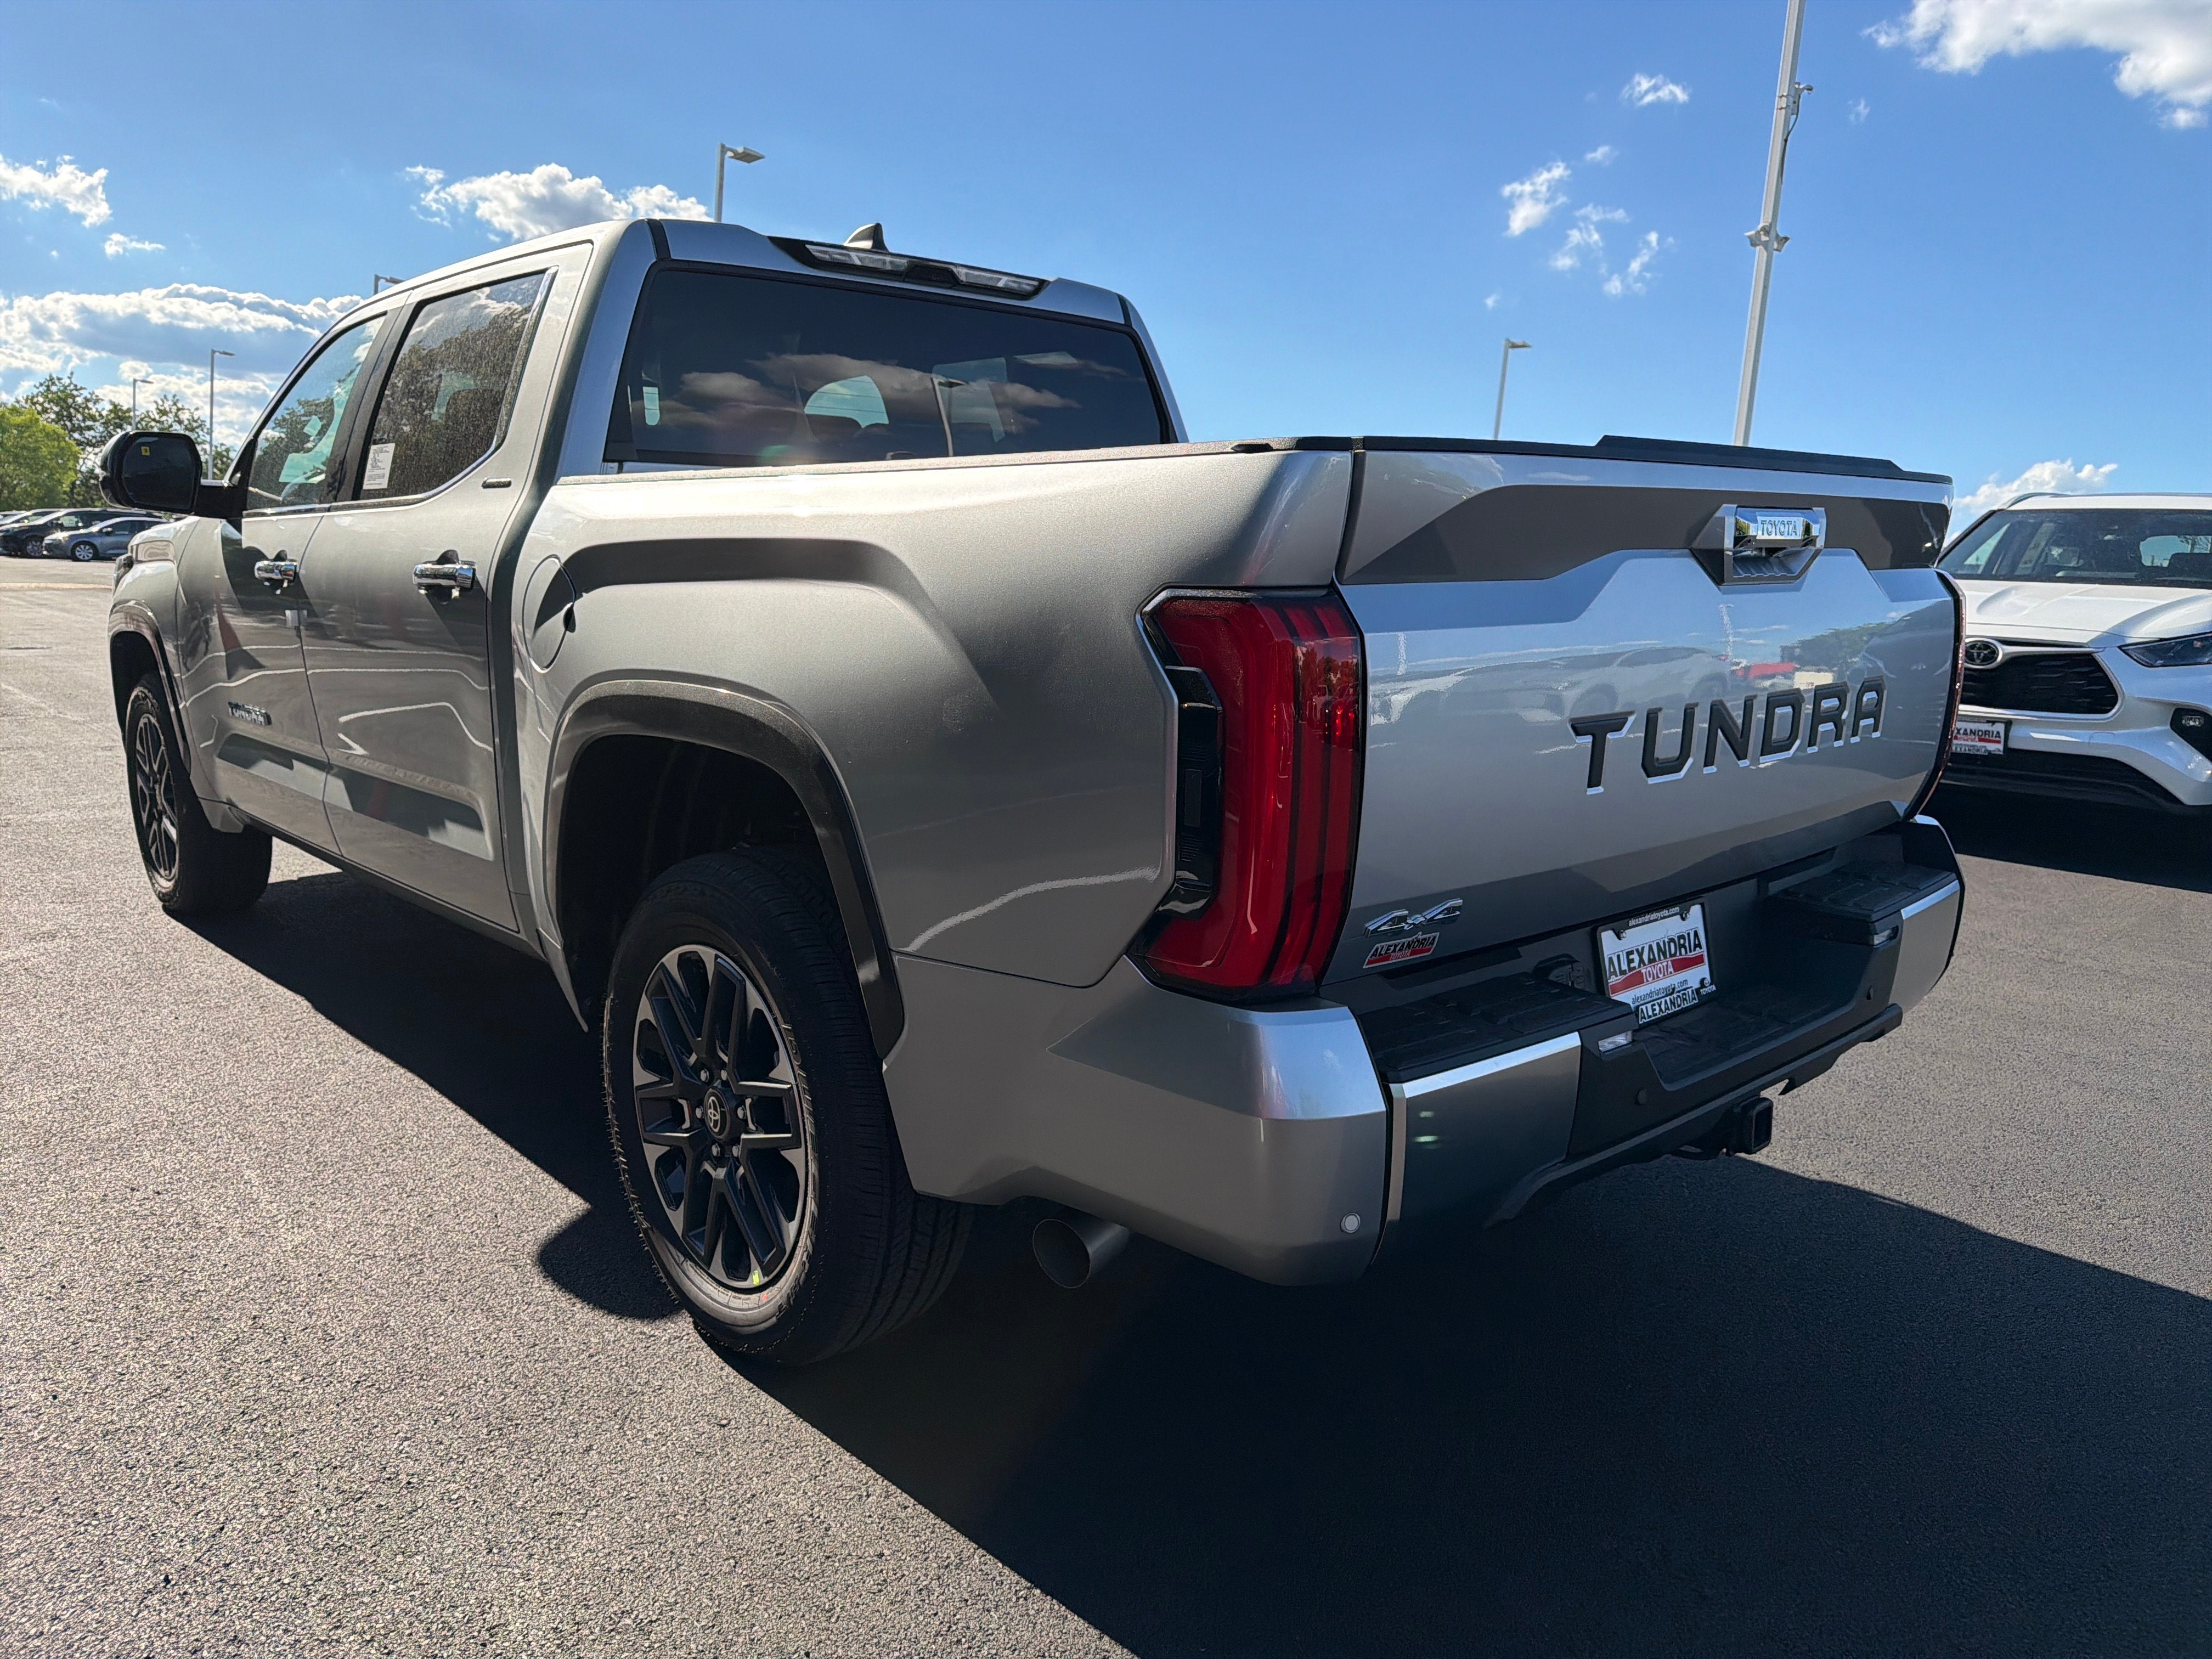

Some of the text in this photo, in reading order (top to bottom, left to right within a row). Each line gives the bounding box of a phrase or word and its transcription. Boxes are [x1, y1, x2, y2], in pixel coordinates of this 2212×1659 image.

[1760, 519, 1798, 537] TOYOTA
[1568, 675, 1887, 795] TUNDRA
[1955, 727, 2001, 740] XANDRIA
[1628, 906, 1680, 927] alexandriatoyota.com
[1371, 936, 1435, 958] ALEXANDRIA
[1390, 950, 1410, 961] TOYOTA
[1607, 929, 1703, 980] ALEXANDRIA
[1641, 961, 1674, 983] TOYOTA
[1632, 978, 1689, 1005] alexandriatoyota.com
[1639, 989, 1698, 1023] ALEXANDRIA
